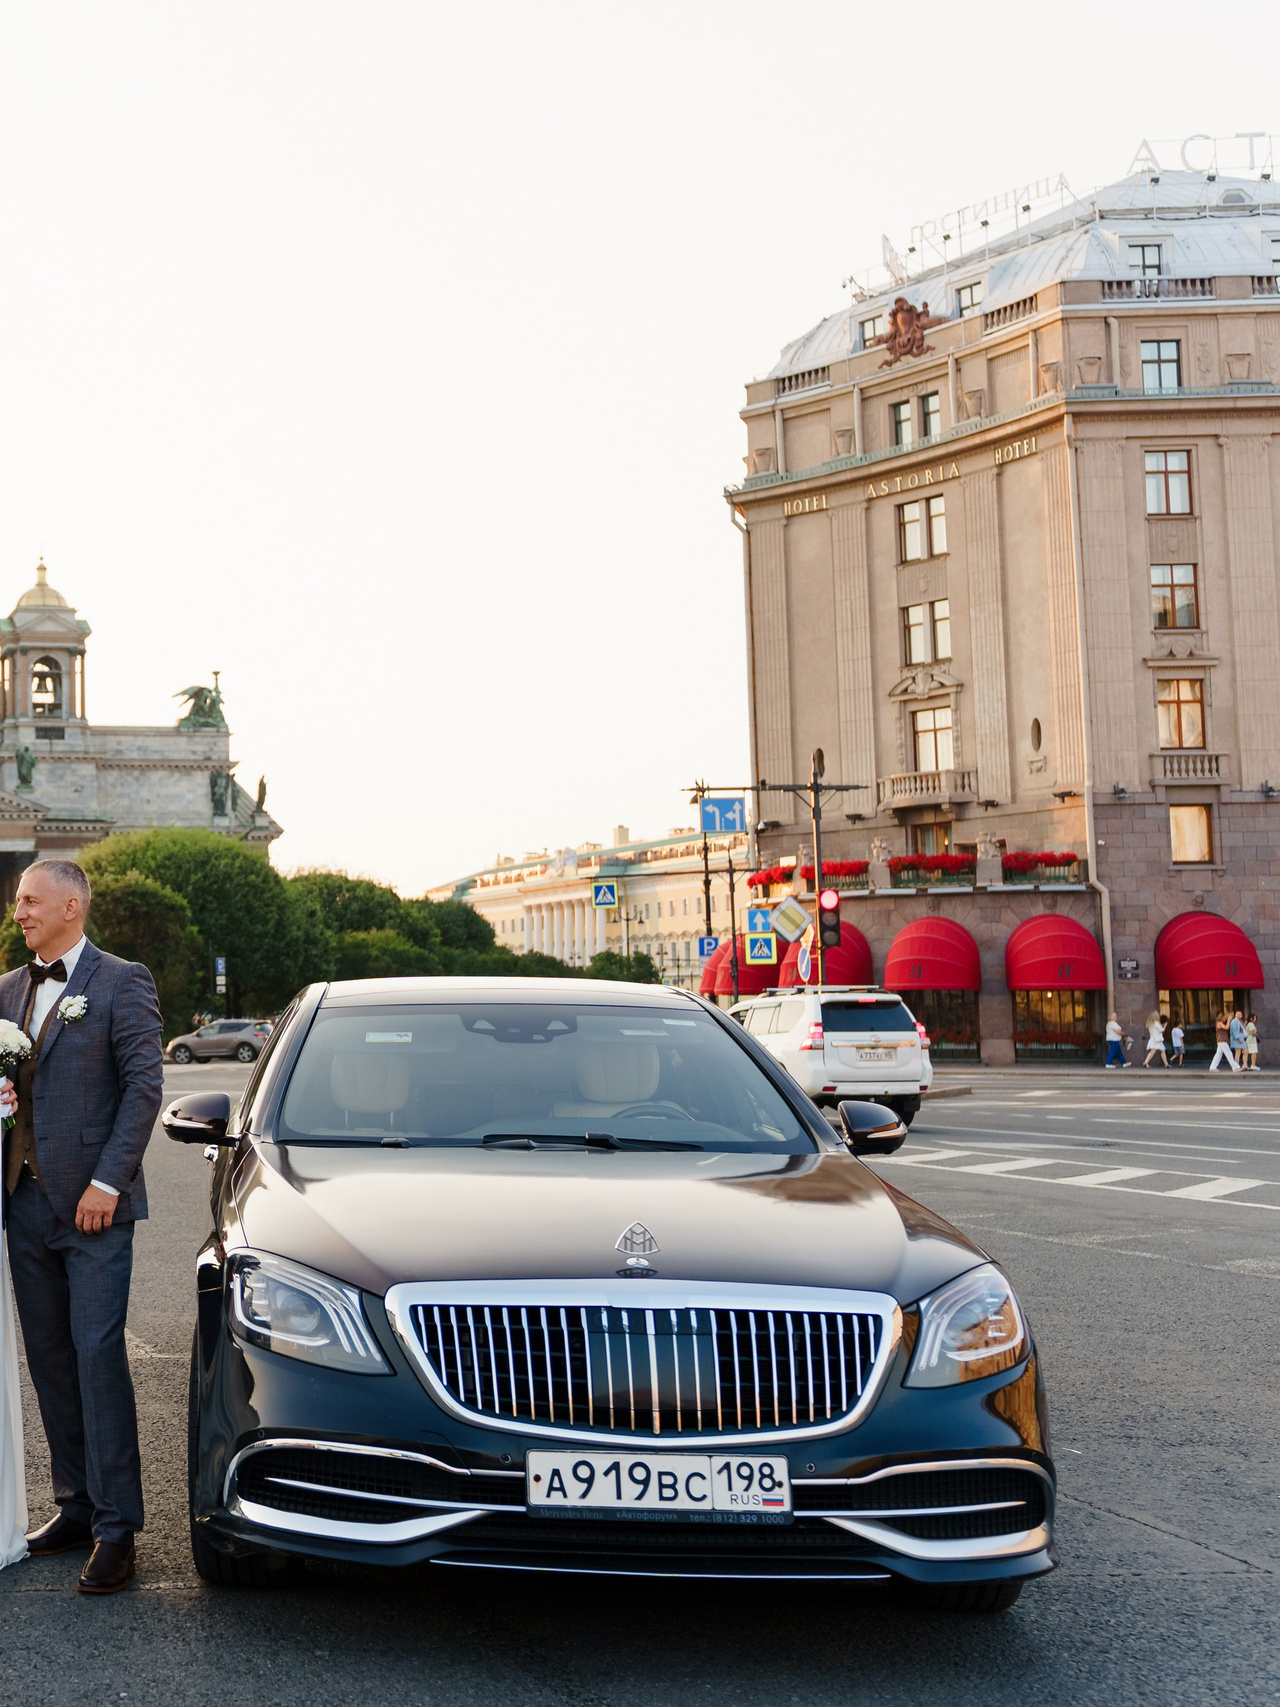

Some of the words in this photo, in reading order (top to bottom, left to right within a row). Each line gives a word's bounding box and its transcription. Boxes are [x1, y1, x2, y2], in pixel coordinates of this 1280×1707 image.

[910, 172, 1070, 244] ГОСТИНИЦА
[783, 494, 829, 516] HOTEL
[867, 462, 960, 499] ASTORIA
[995, 436, 1038, 465] HOTEL
[703, 938, 717, 955] P
[716, 1461, 777, 1492] 198
[730, 1494, 761, 1506] RUS
[540, 1508, 604, 1519] Mercedes-Benz
[712, 1514, 737, 1524] (812)
[740, 1515, 758, 1523] 329
[761, 1515, 785, 1524] 1000
